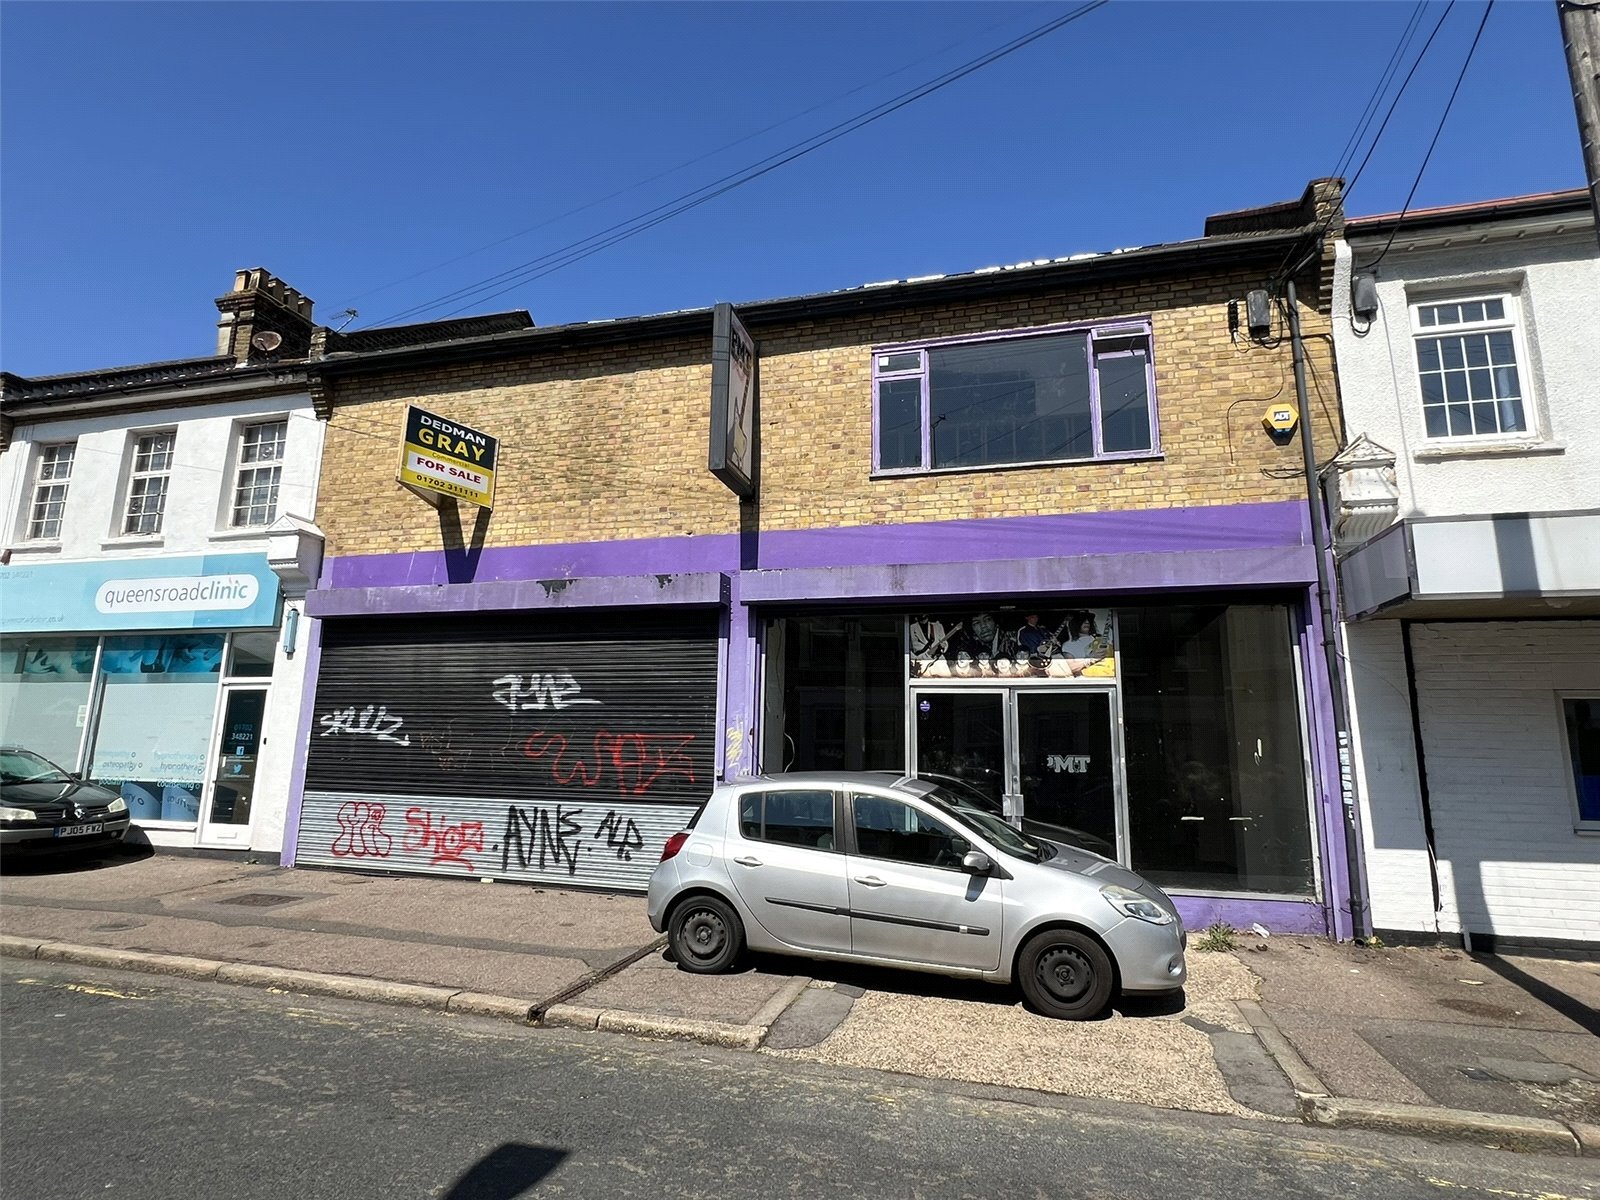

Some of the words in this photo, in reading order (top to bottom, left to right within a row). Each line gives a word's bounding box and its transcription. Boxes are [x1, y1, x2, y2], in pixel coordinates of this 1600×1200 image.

[420, 415, 486, 446] DEDMAN
[1274, 412, 1290, 421] ADT
[418, 428, 485, 461] GRAY
[416, 456, 446, 473] FOR
[448, 467, 482, 484] SALE
[416, 474, 446, 487] 01702
[447, 484, 478, 498] 311111
[105, 578, 248, 607] queensroadclinic
[60, 825, 84, 836] PJ05
[85, 824, 102, 834] FWZ
